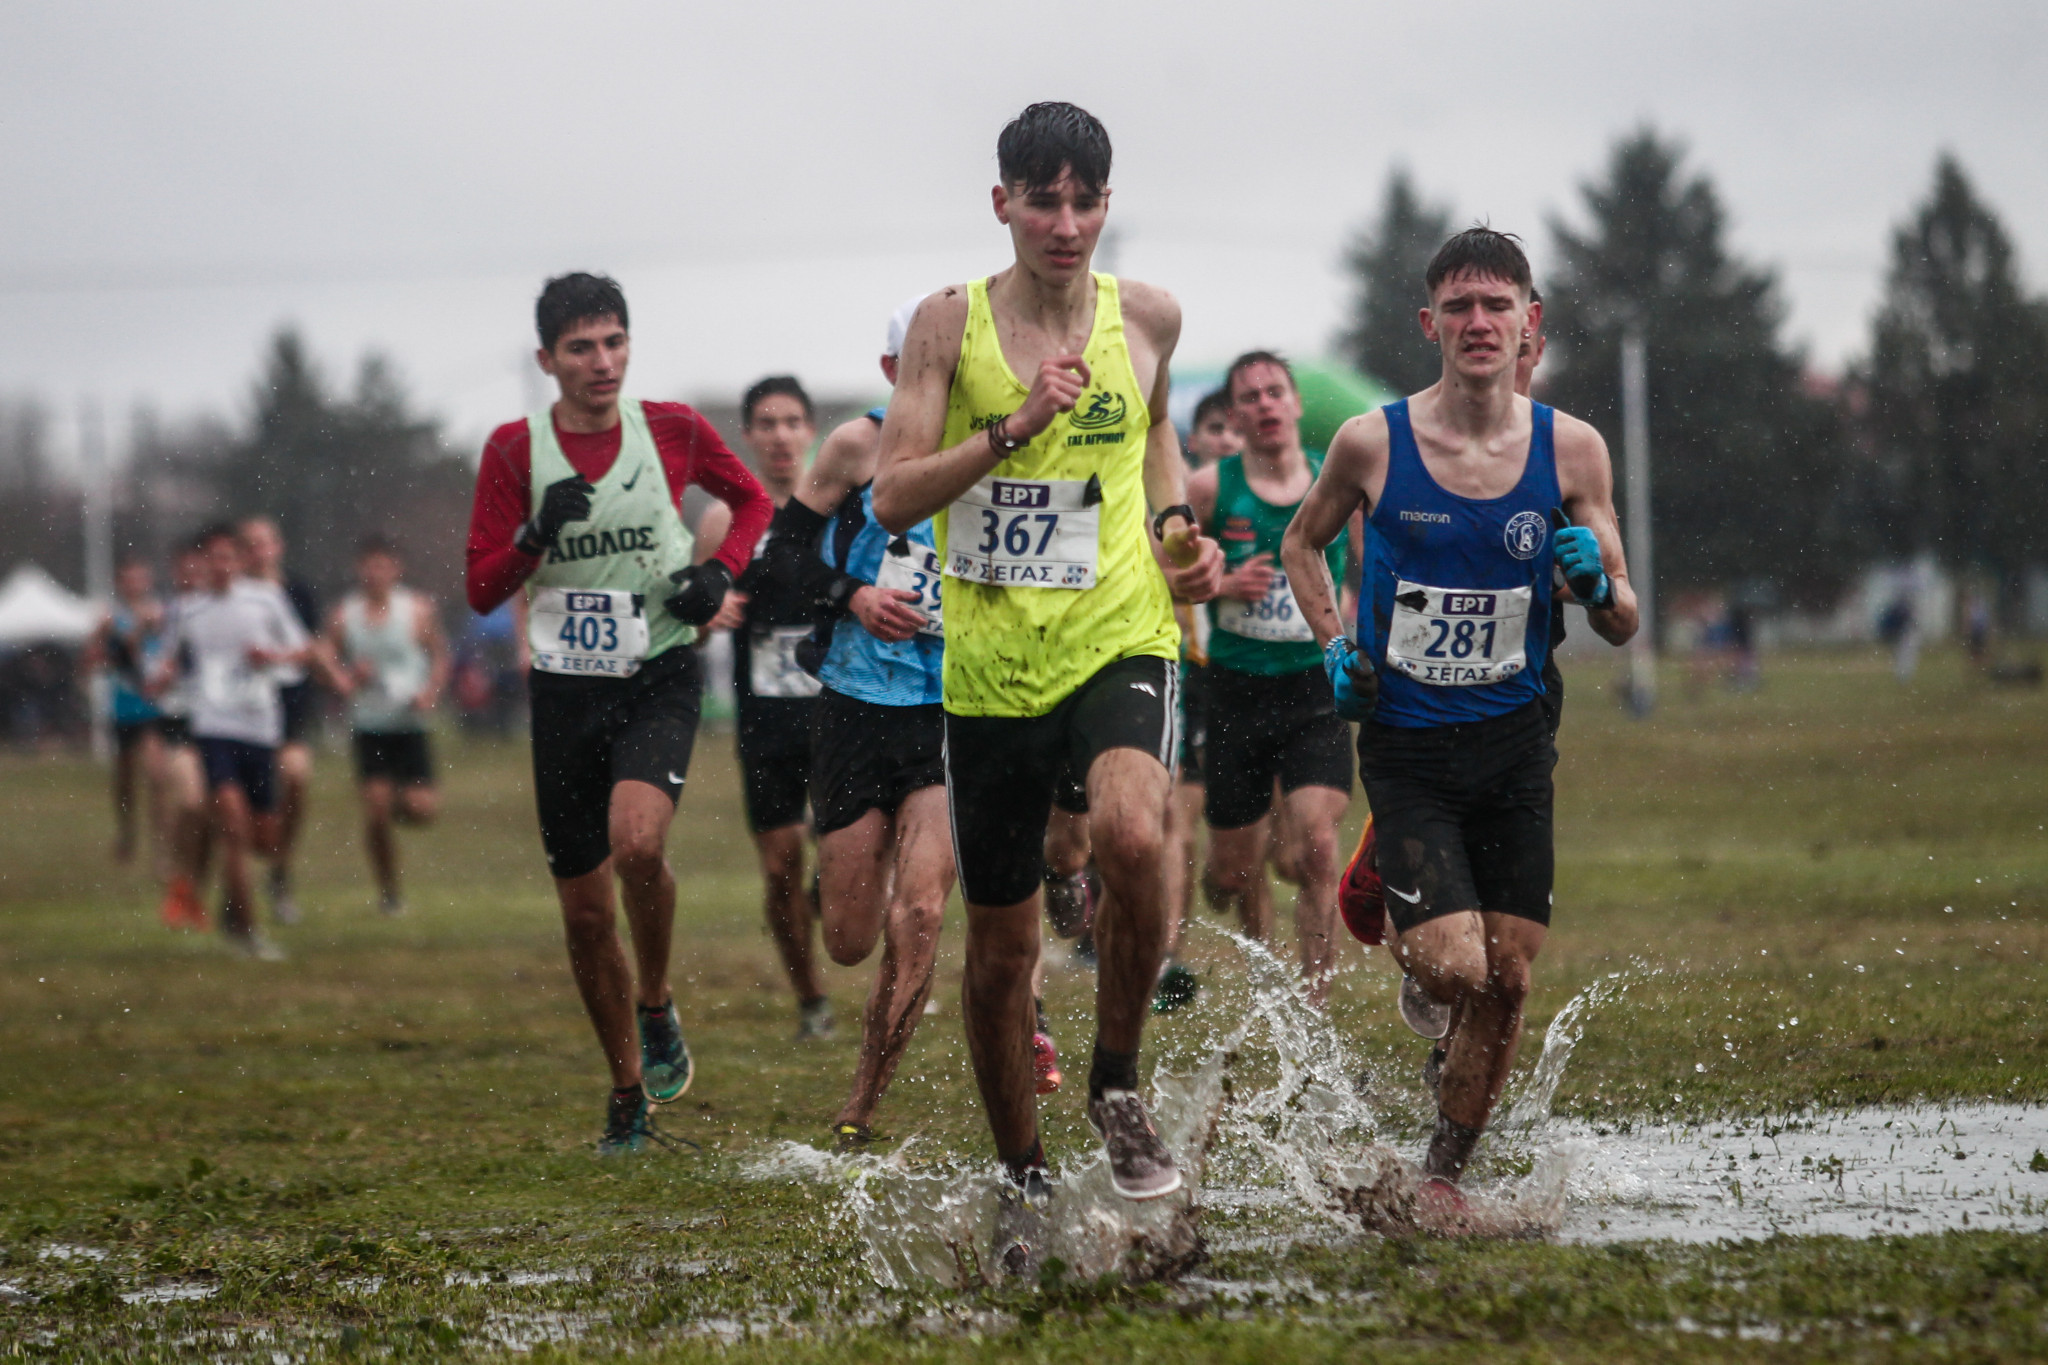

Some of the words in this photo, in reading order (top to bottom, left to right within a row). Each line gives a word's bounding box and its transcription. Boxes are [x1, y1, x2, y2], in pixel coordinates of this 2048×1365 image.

[1000, 486, 1041, 505] ΕΡΤ
[1400, 510, 1450, 524] macron
[978, 510, 1059, 556] 367
[548, 527, 655, 564] ΑΙΟΛΟΣ
[979, 563, 1053, 582] ΣΕΓΑΣ
[909, 572, 942, 611] 39
[572, 595, 605, 610] ΕΡΤ
[1451, 597, 1488, 612] ΕΡΤ
[559, 616, 618, 651] 403
[1424, 619, 1496, 659] 281
[561, 657, 617, 673] ΣΕΓΑΣ
[1424, 666, 1492, 681] ΣΕΓΑΣ
